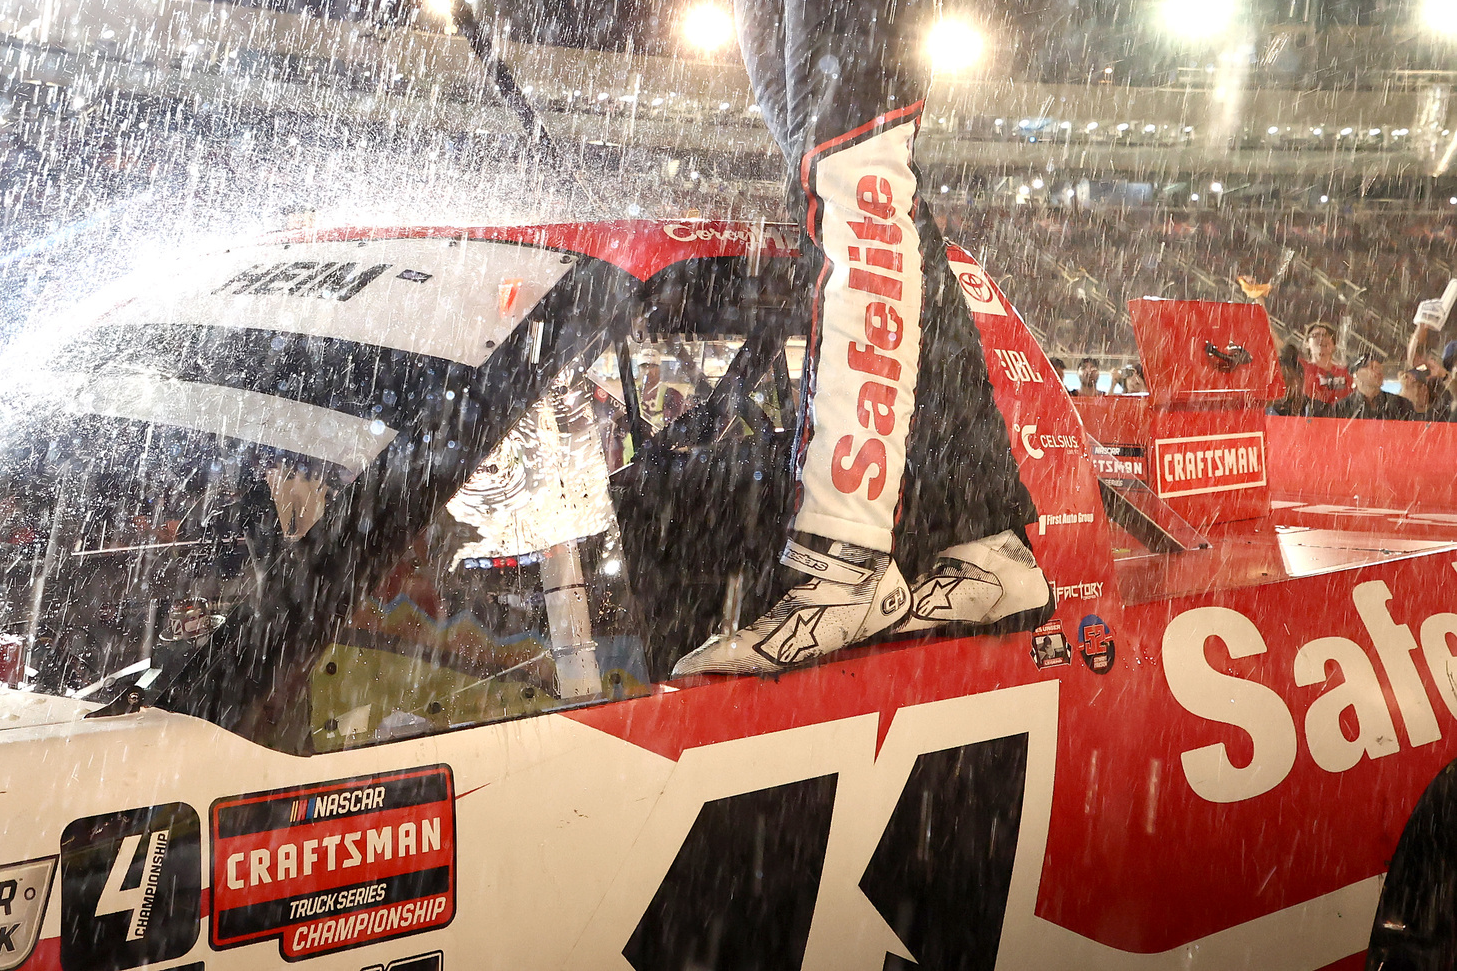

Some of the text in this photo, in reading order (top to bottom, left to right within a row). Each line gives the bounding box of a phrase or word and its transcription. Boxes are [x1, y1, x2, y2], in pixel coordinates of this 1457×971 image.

[831, 174, 904, 501] Safelite
[999, 350, 1043, 383] JBL
[1040, 434, 1078, 448] CELSIUS
[1163, 446, 1260, 482] CRAFTSMAN
[1047, 514, 1062, 525] First
[1062, 513, 1078, 524] Auto
[1078, 512, 1094, 523] Group
[313, 786, 386, 819] NASCAR
[227, 817, 441, 890] CRAFTSMAN
[94, 829, 170, 942] 4
[134, 832, 169, 937] CHAMPIONSHIP
[289, 883, 387, 920] TRUCK SERIES
[292, 897, 446, 952] CHAMPIONSHIP
